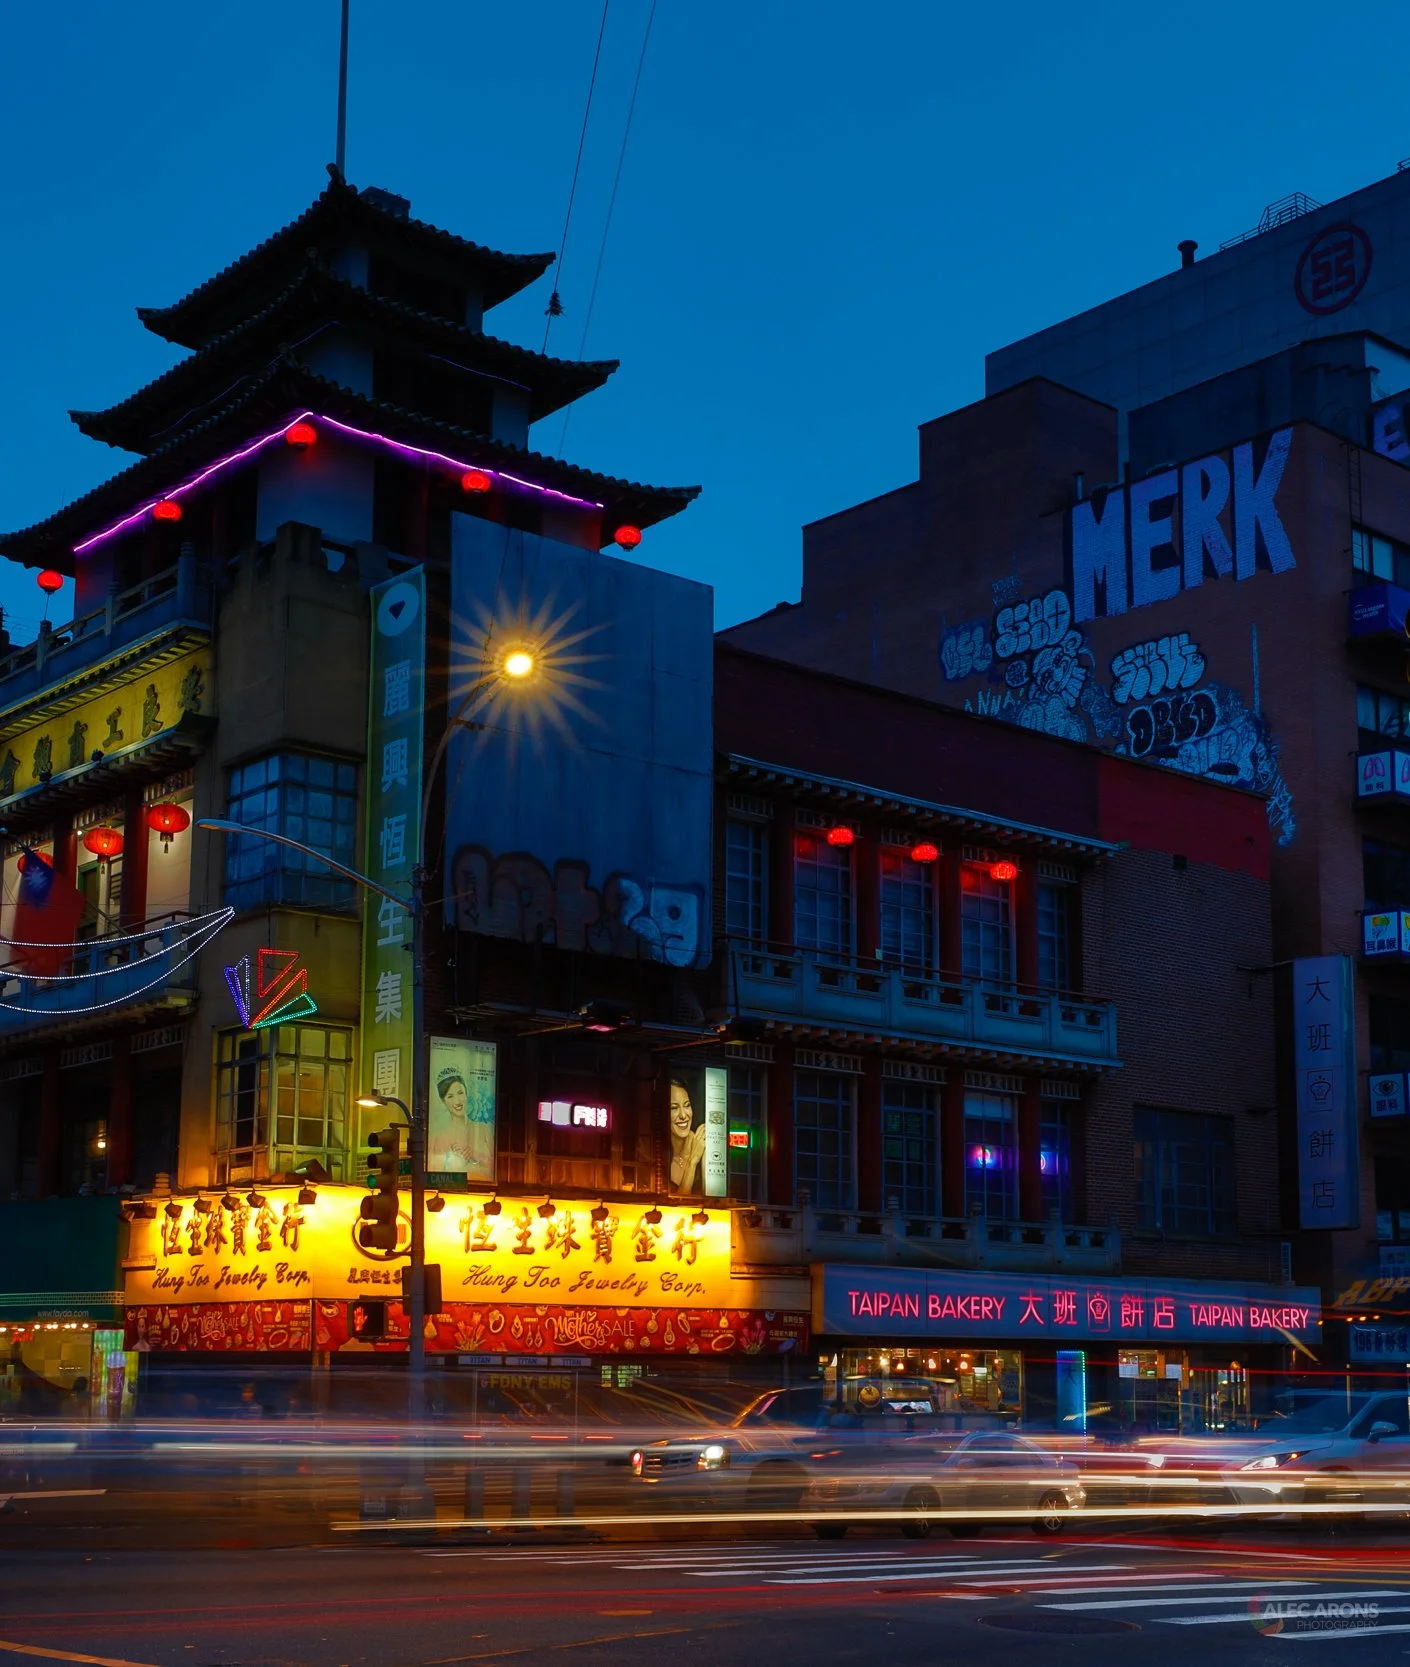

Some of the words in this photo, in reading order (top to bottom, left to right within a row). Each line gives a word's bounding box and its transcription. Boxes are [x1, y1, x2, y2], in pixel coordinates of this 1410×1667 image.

[1071, 426, 1296, 624] MERK
[1305, 976, 1331, 1052] 大班
[1308, 1130, 1335, 1209] 餅店
[152, 1268, 185, 1294] Hung
[187, 1264, 210, 1287] Too
[215, 1264, 268, 1290] Jewelry
[275, 1262, 310, 1289] Corp.
[462, 1265, 518, 1294] Hung
[523, 1265, 561, 1289] Too
[568, 1267, 649, 1296] Jewelry
[660, 1272, 707, 1298] Corp.
[848, 1290, 919, 1319] TAIPAN
[927, 1294, 1005, 1320] BAKERY
[1018, 1288, 1078, 1326] 大班
[1120, 1297, 1176, 1330] 餅店
[1189, 1303, 1244, 1328] TAIPAN
[1249, 1306, 1309, 1330] BAKERY
[604, 1319, 636, 1337] SALE
[470, 1356, 490, 1364] TITAN
[489, 1375, 533, 1389] FDNY
[538, 1375, 572, 1390] EMS
